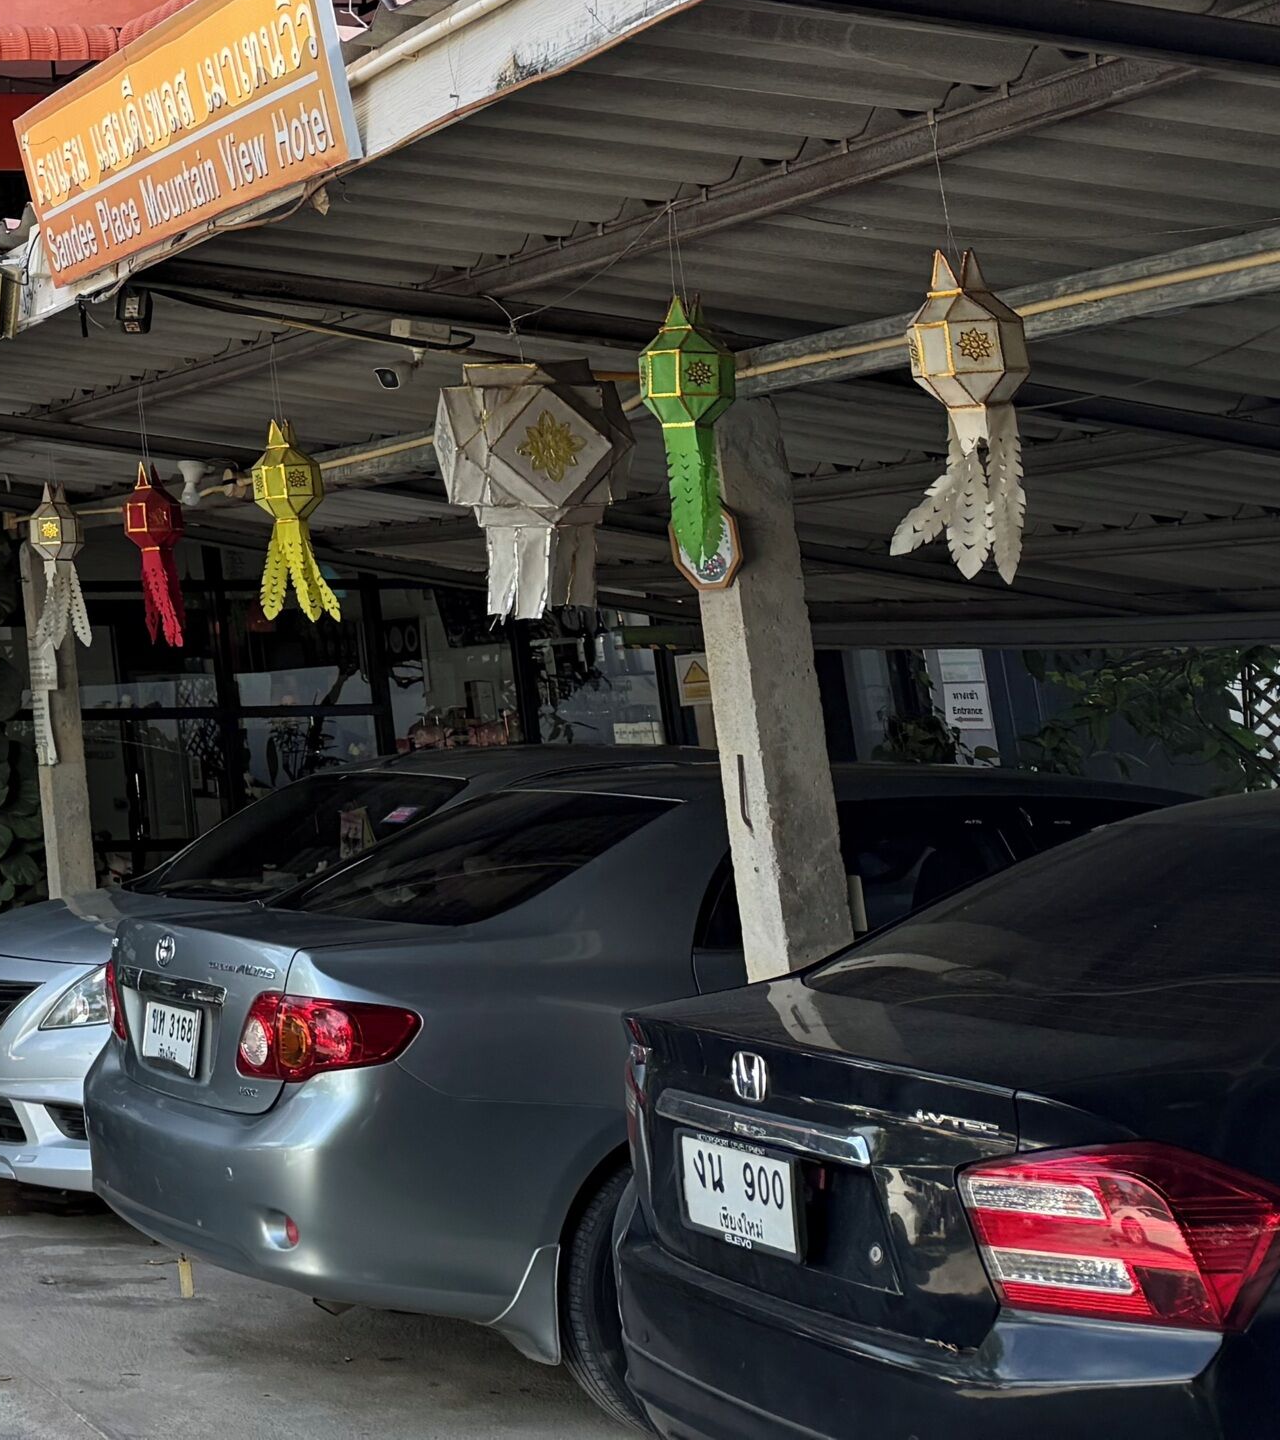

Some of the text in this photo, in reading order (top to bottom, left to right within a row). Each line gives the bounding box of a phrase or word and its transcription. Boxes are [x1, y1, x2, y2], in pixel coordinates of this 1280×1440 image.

[22, 132, 90, 207] โรงแรม
[89, 73, 196, 171] แสนดีเพลส
[47, 89, 336, 272] Sandee Place Mountain View Hotel
[952, 706, 984, 716] Entrance
[169, 1014, 194, 1044] 3168
[693, 1149, 784, 1211] งน 900
[719, 1206, 765, 1240] เชียงใหม่
